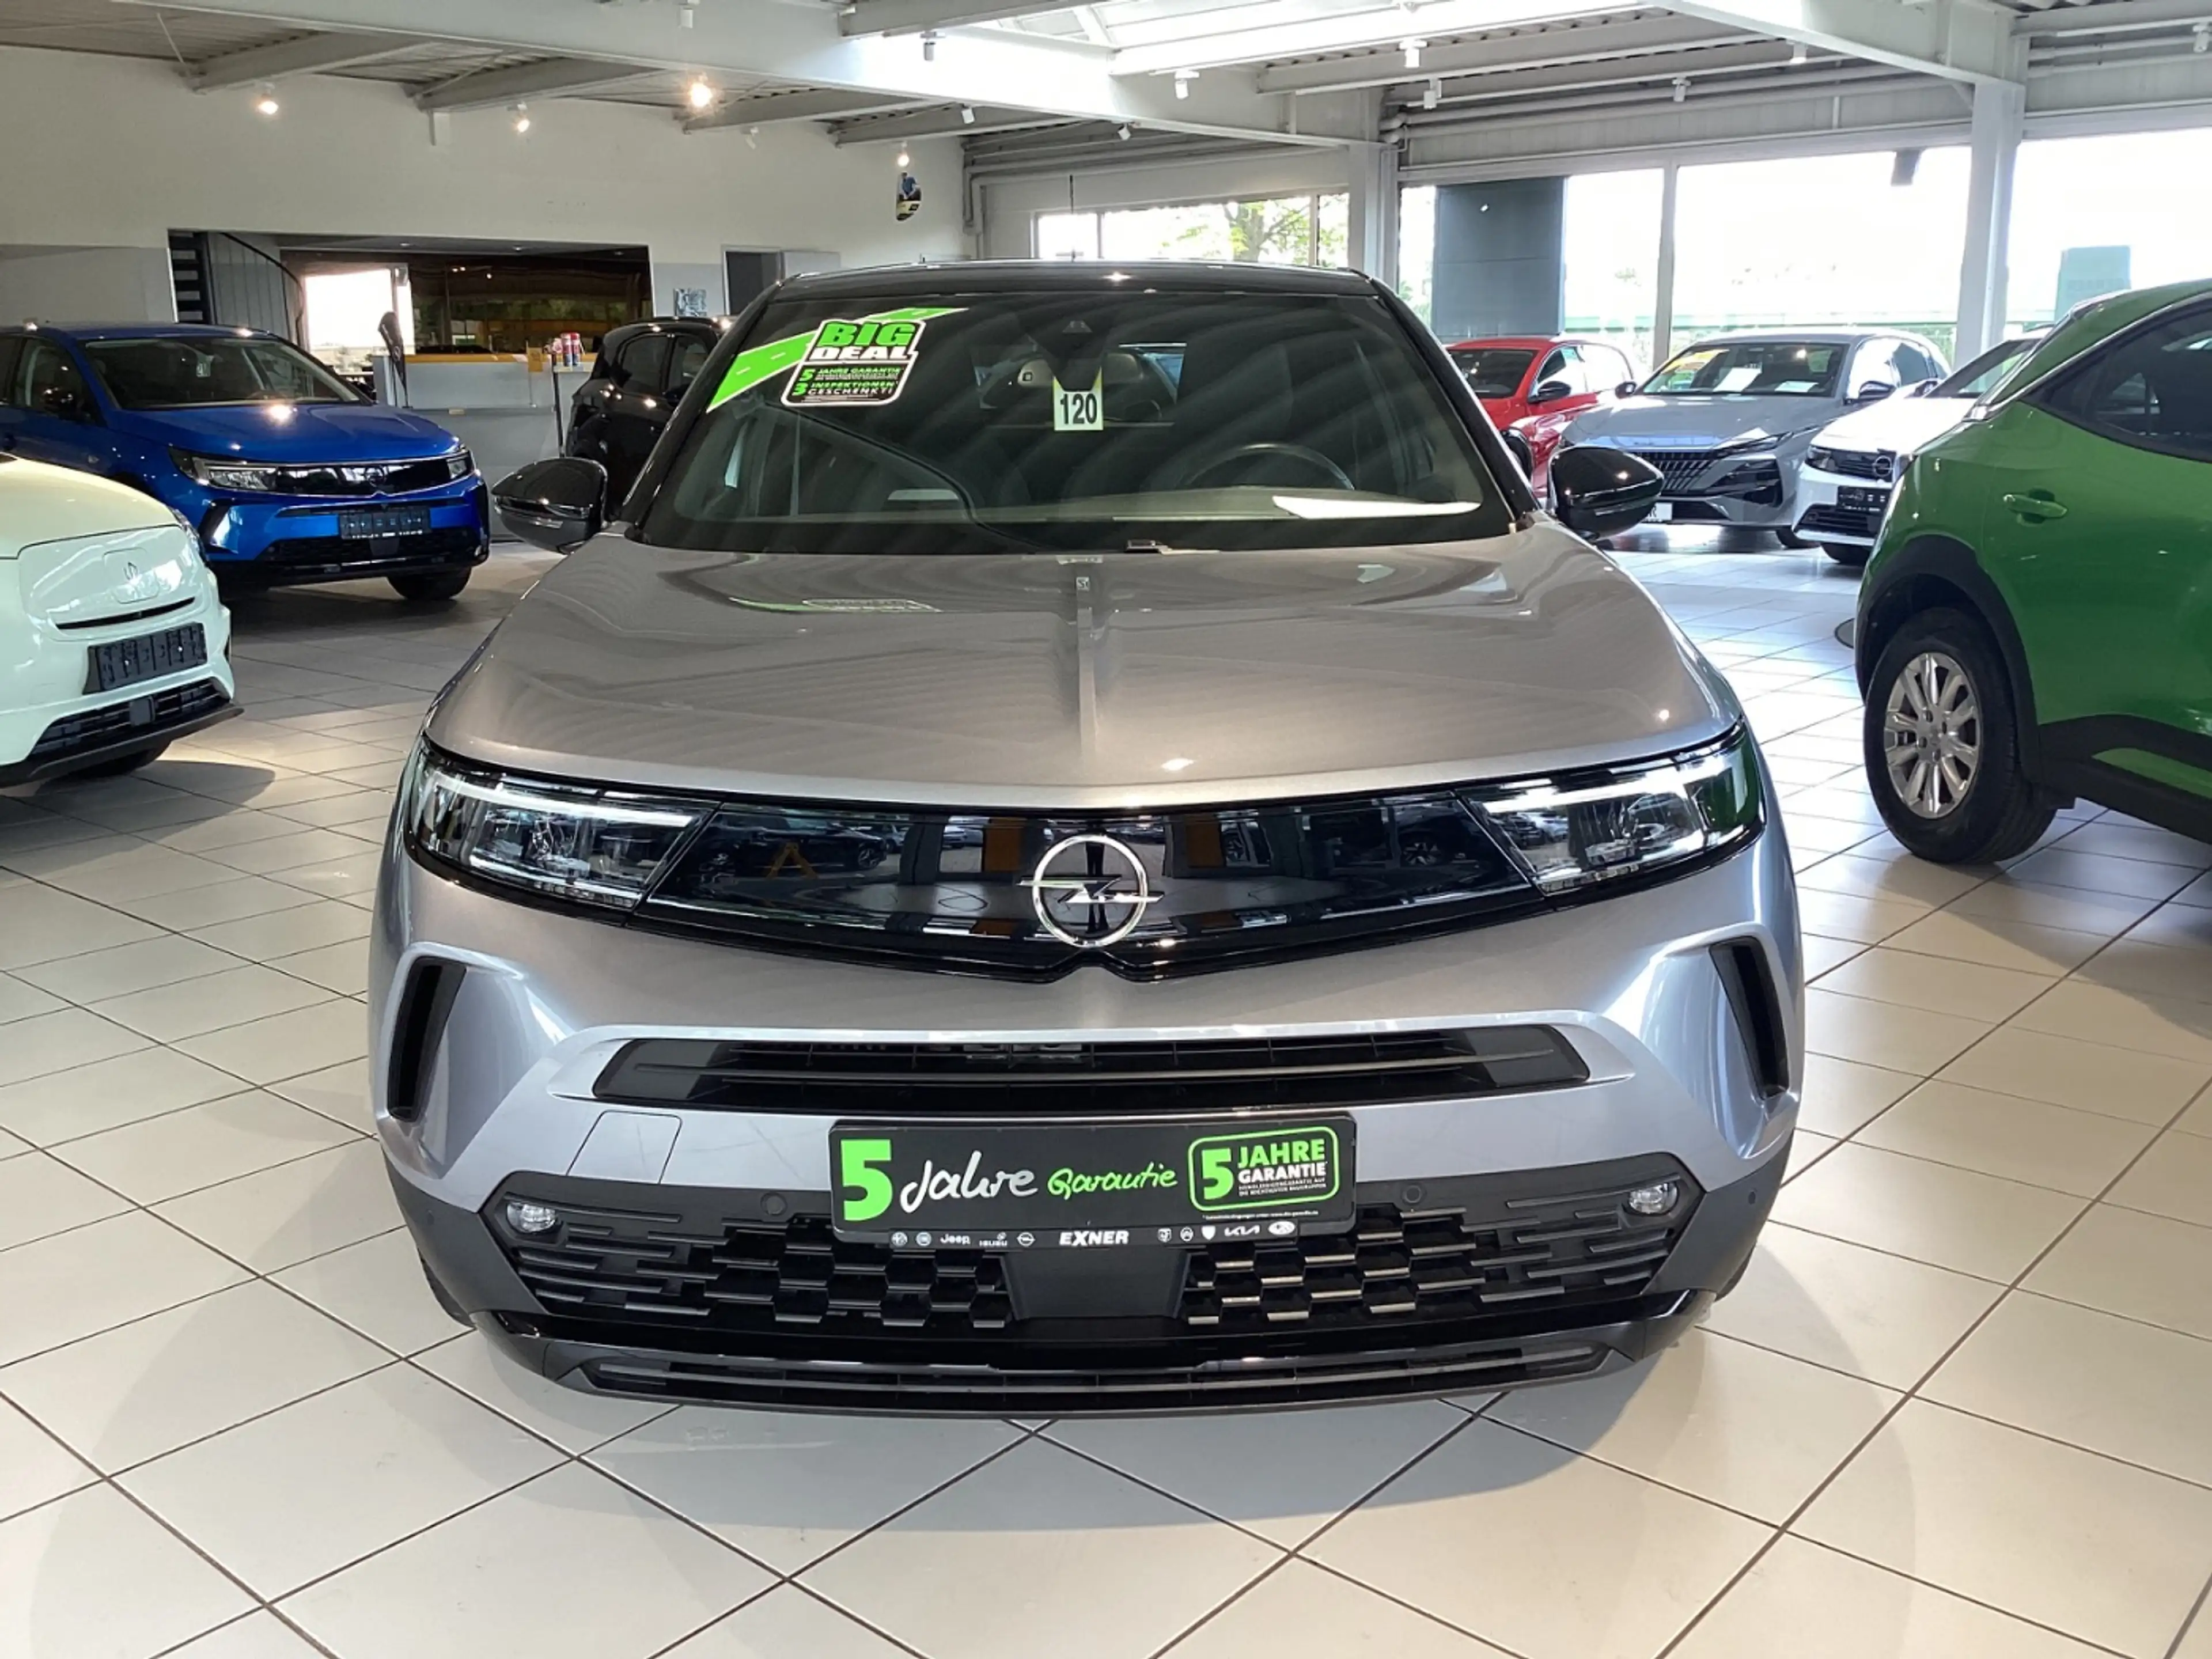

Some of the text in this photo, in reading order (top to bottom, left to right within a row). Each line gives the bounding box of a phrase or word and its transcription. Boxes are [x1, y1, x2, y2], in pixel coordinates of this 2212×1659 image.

[816, 322, 916, 346] BIG
[809, 346, 908, 360] DEAL
[799, 368, 816, 381] 5
[791, 382, 808, 396] 3
[1060, 393, 1097, 425] 120
[1201, 1138, 1325, 1200] 5 JAHRE
[840, 1139, 1179, 1221] 5 Jahre Garantie
[940, 1233, 971, 1245] Jeep
[1059, 1230, 1130, 1247] EXNER
